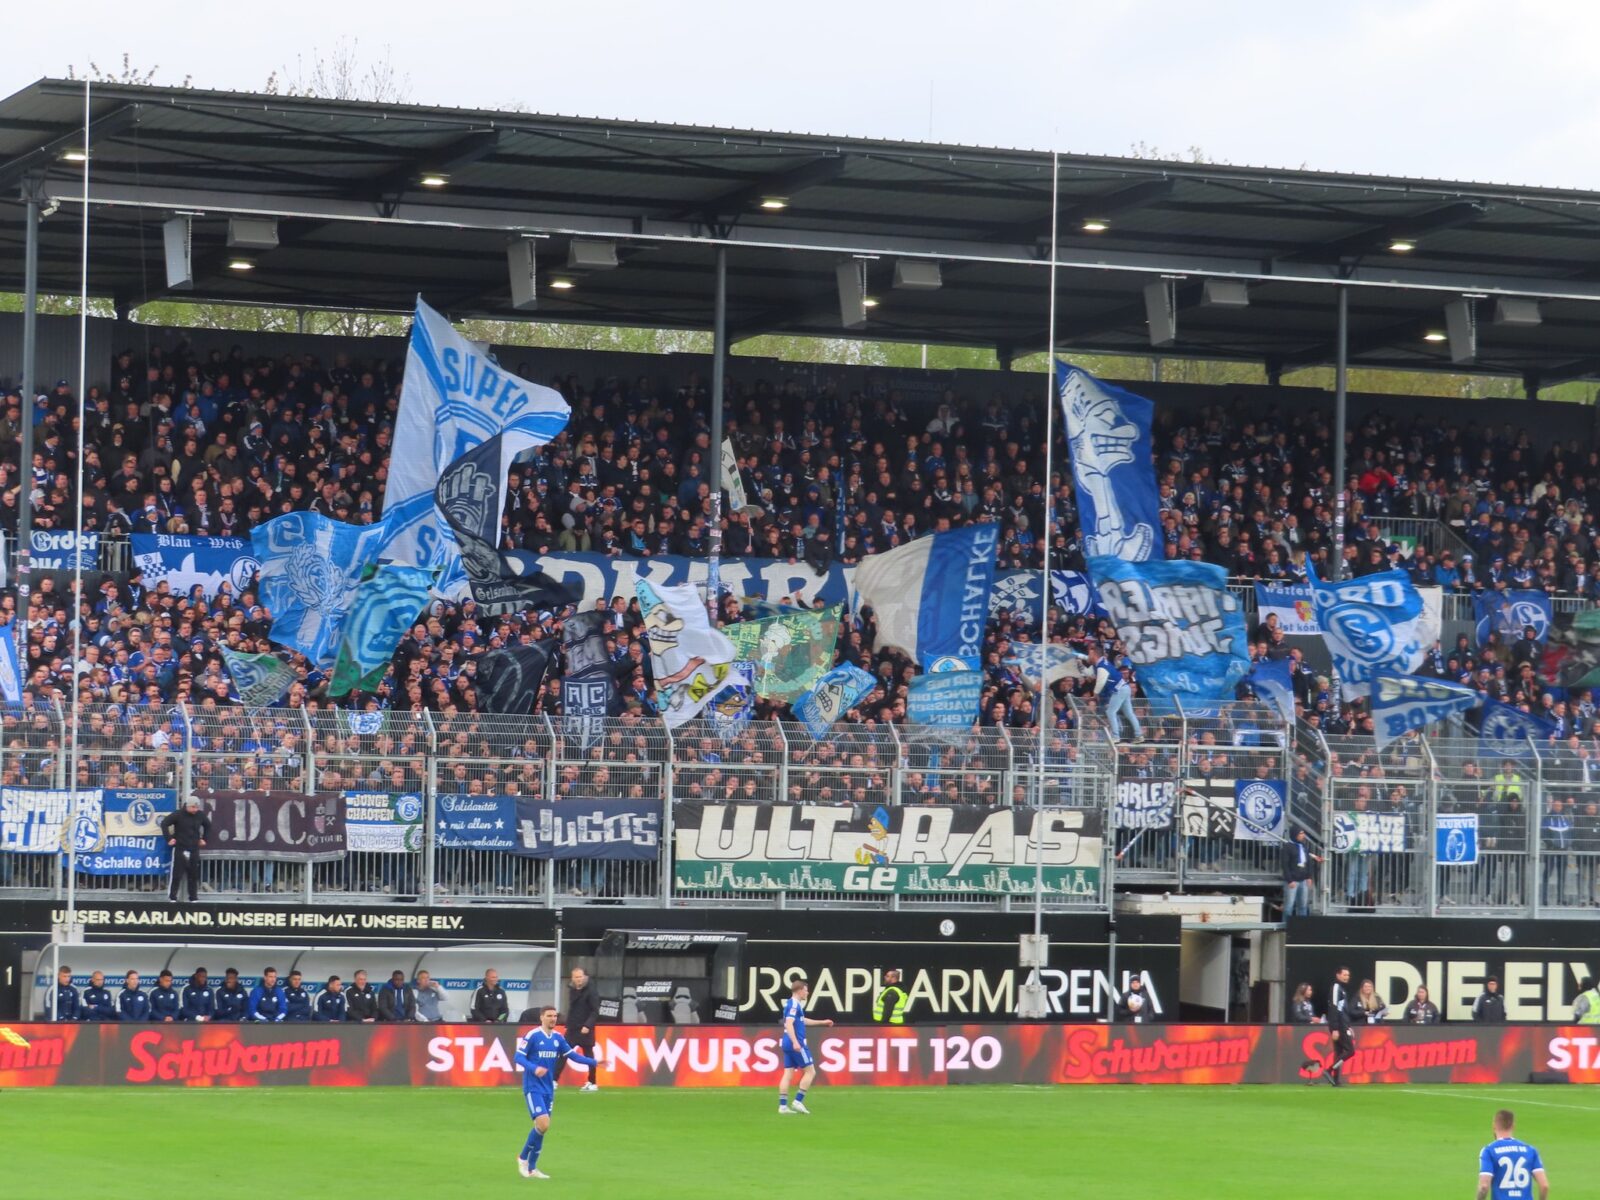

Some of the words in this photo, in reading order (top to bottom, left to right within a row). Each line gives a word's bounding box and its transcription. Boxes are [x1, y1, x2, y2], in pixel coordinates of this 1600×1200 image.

[157, 534, 191, 548] Blau
[1, 789, 103, 823] SUPPORERS
[1116, 782, 1174, 809] ARLER
[1, 823, 62, 852] CLUB
[517, 808, 658, 849] HUGOS
[1357, 814, 1404, 834] BLUE
[1437, 818, 1477, 828] KURVE
[95, 856, 142, 869] Schalke
[145, 856, 161, 869] 04
[114, 911, 214, 926] SAARLAND.
[218, 912, 286, 927] UNSERE
[290, 913, 357, 928] HEIMAT.
[362, 915, 428, 929] UNSERE
[432, 916, 464, 929] ELV.
[1375, 960, 1486, 1021] DIE
[126, 1030, 340, 1083] Schwamm
[538, 1050, 559, 1058] VELTIN
[819, 1037, 918, 1072] SEIT
[930, 1035, 1002, 1072] 120
[1064, 1028, 1249, 1078] Schwamm
[1299, 1031, 1477, 1079] Swamm
[1498, 1156, 1530, 1189] 26
